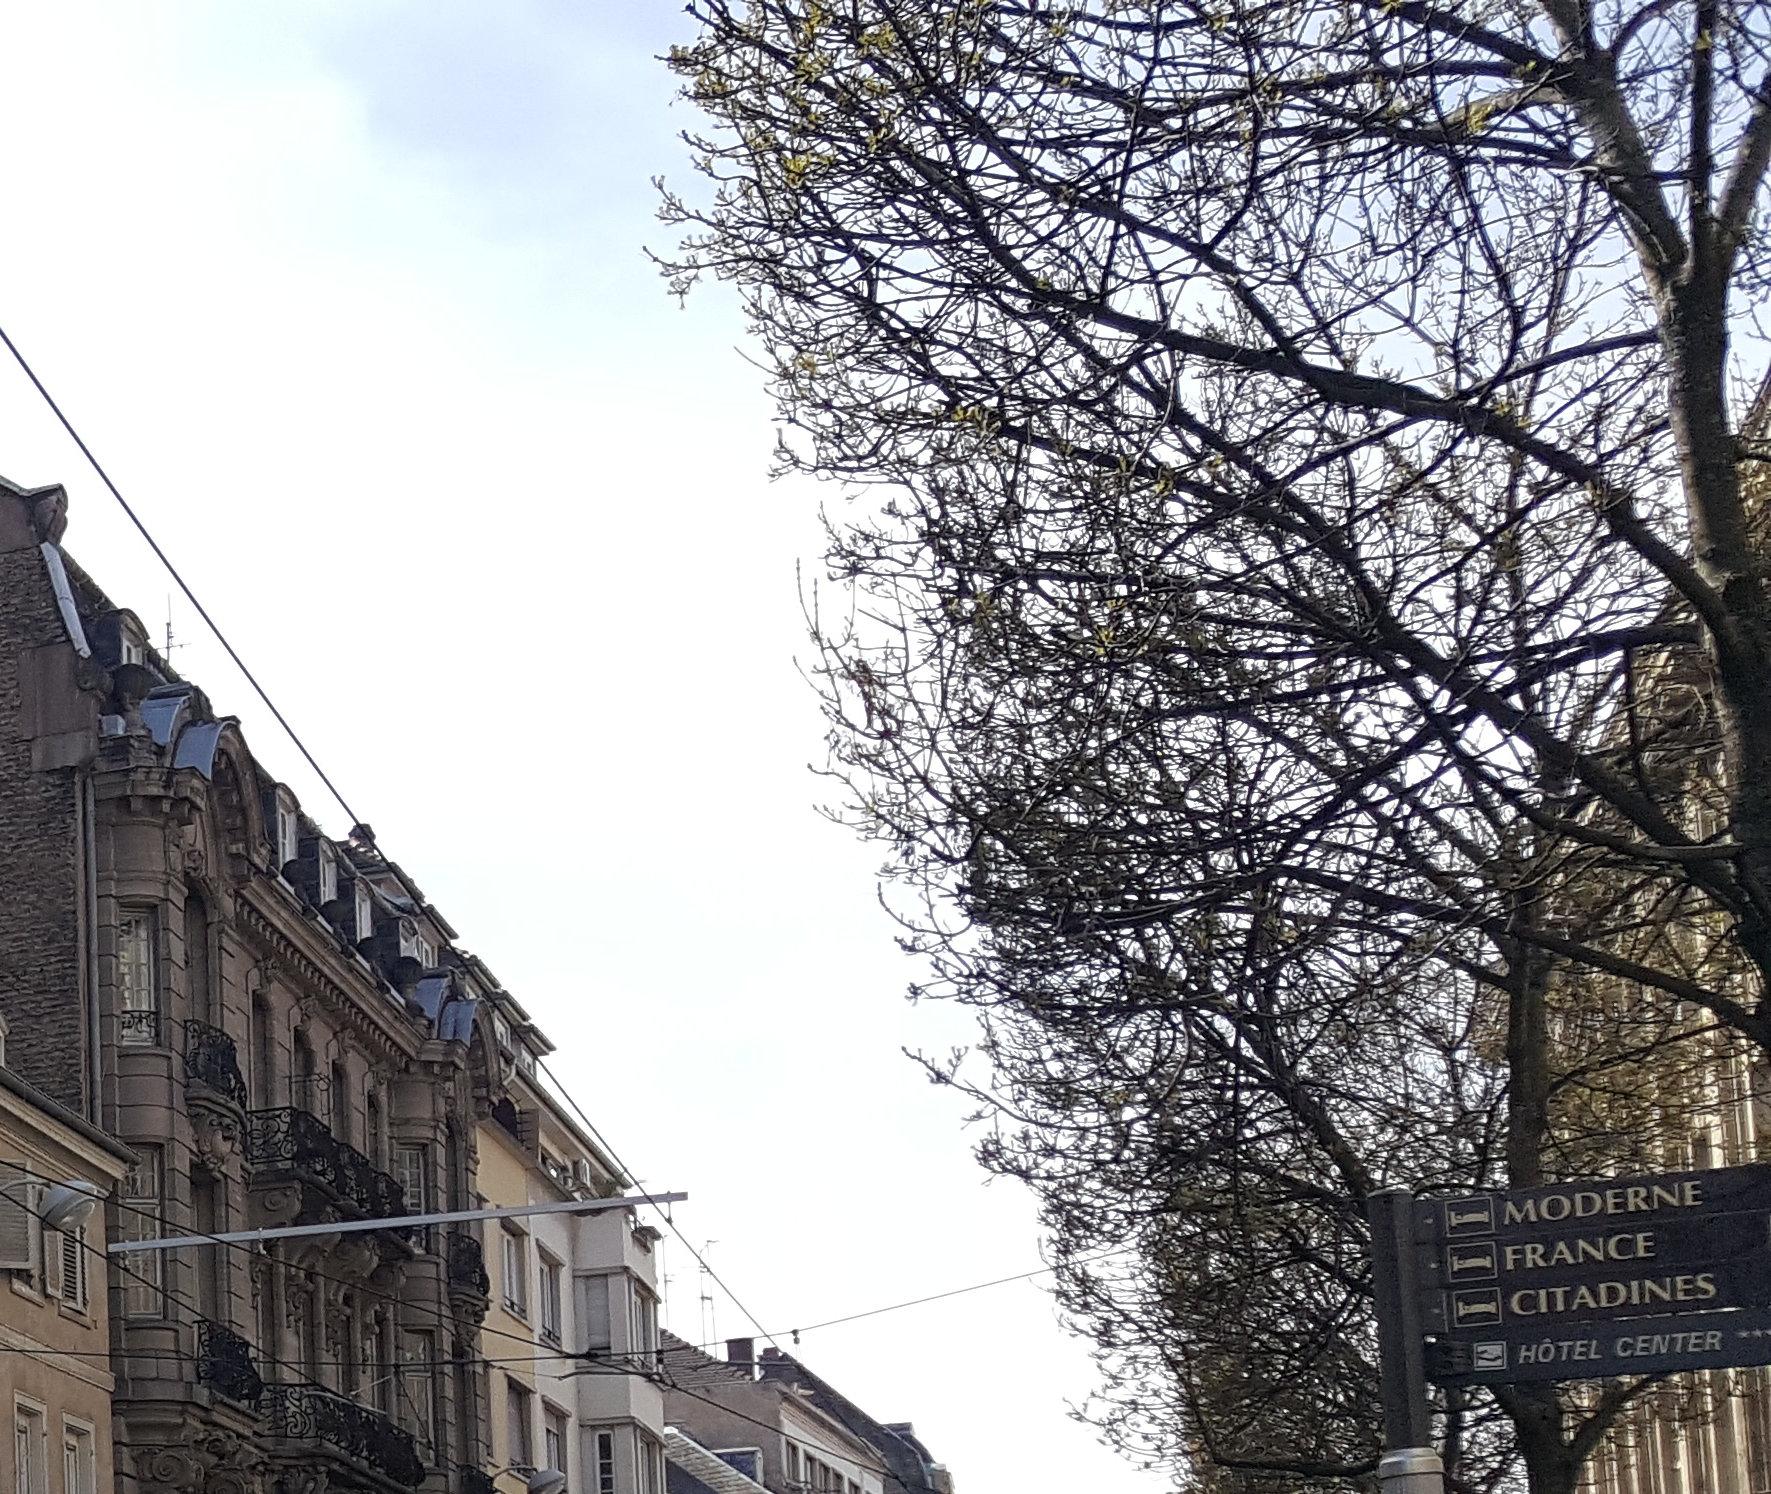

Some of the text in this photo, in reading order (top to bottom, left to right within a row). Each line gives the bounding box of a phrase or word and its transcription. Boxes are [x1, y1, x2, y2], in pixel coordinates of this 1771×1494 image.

[1504, 1180, 1704, 1225] MODERNE
[1505, 1231, 1656, 1270] FRANCE
[1510, 1272, 1717, 1316] CITADINES
[1518, 1330, 1723, 1364] HÔTEL CENTER
